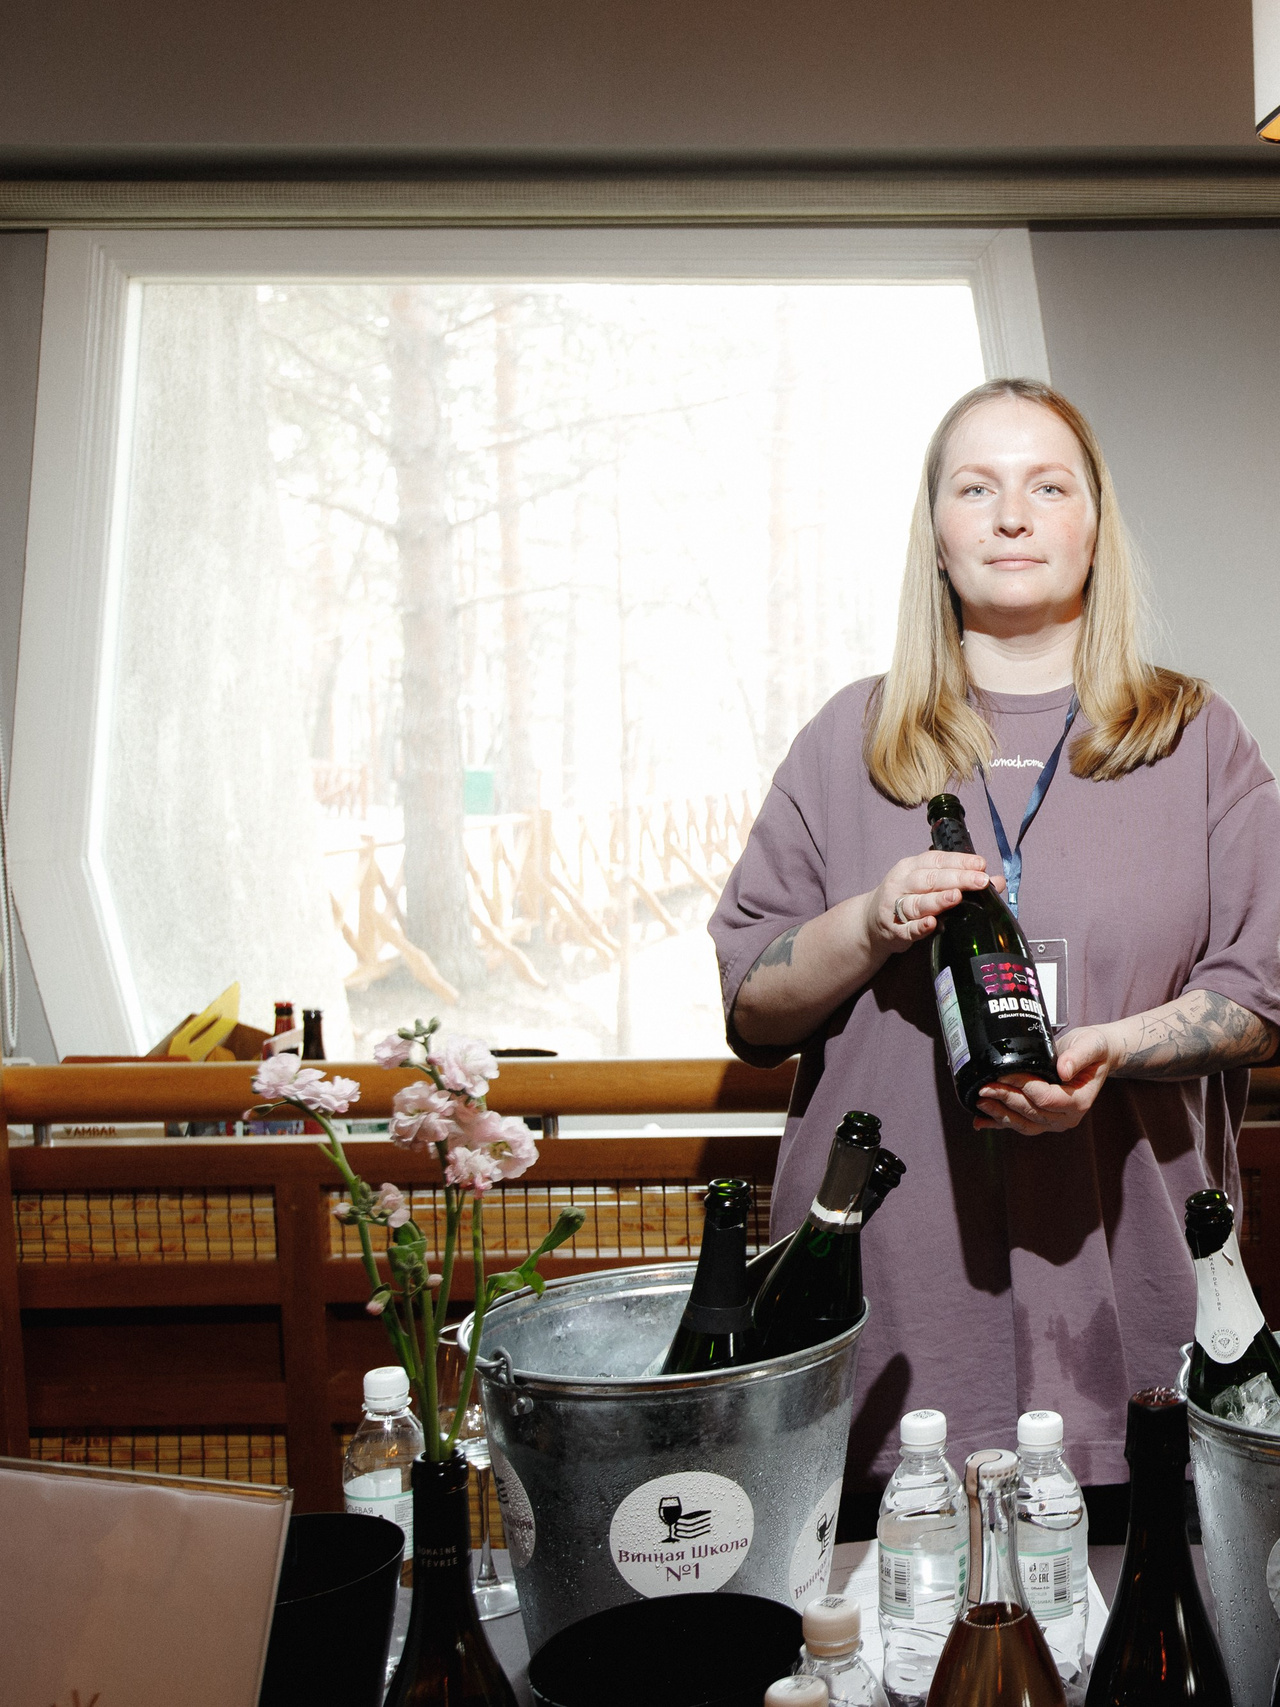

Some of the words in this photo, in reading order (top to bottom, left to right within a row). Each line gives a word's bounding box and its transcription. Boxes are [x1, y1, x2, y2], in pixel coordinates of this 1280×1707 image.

[988, 997, 1019, 1014] BAD
[618, 1549, 686, 1564] Винная
[691, 1537, 749, 1559] Школа
[665, 1562, 700, 1582] №1
